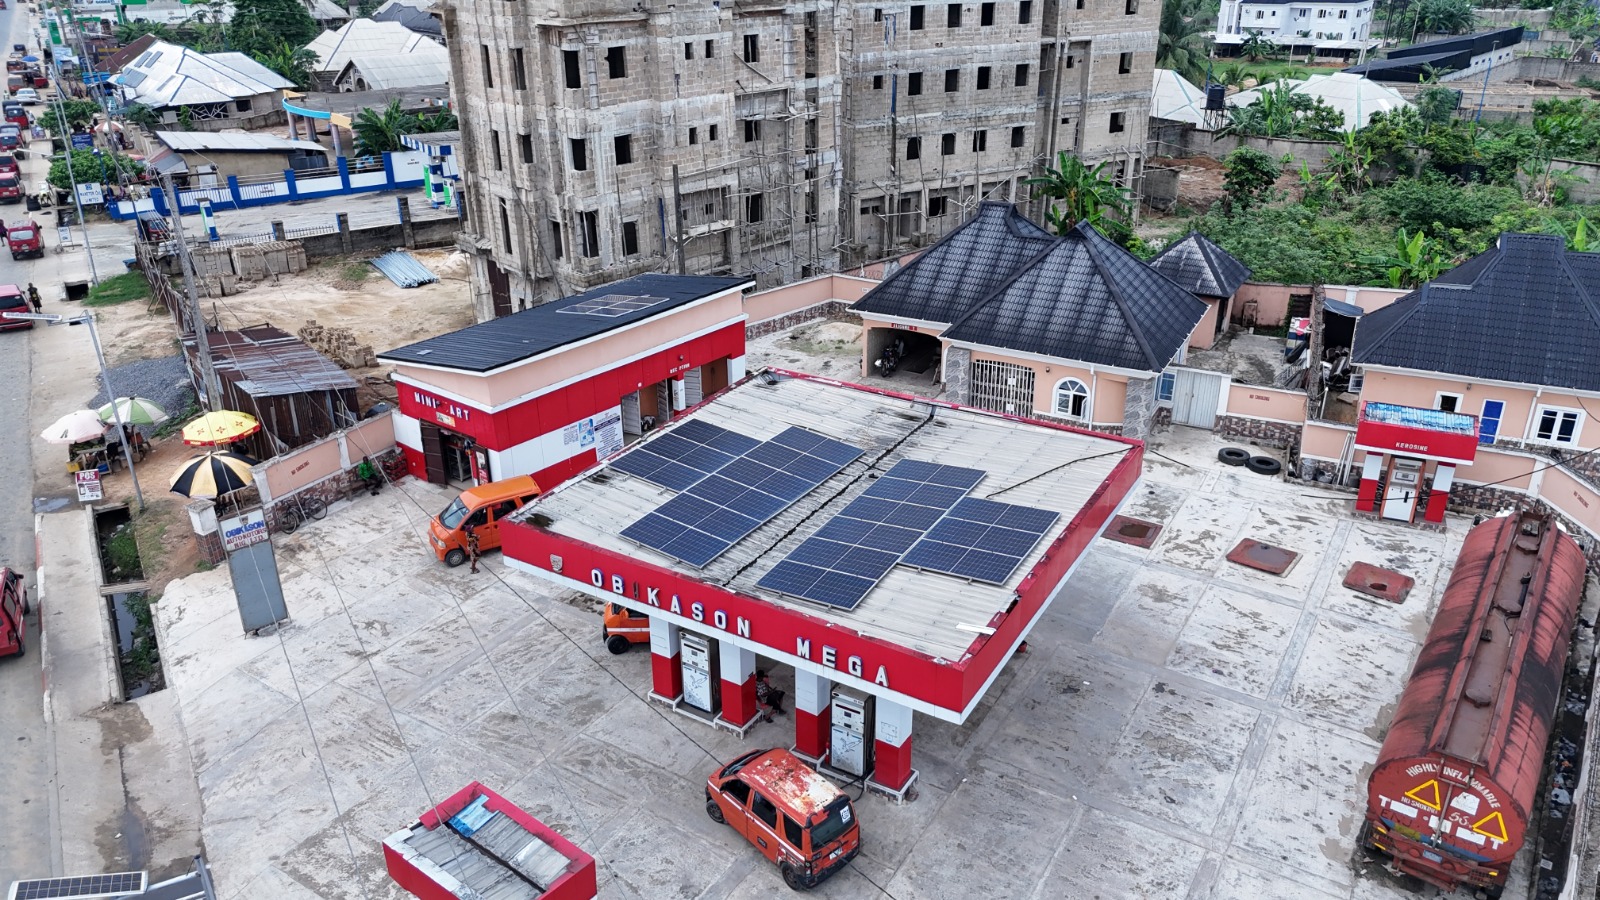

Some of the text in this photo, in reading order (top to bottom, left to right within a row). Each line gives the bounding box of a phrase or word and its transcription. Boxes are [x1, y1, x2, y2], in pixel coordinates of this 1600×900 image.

[414, 392, 437, 408] MINI
[1396, 442, 1429, 452] KEROSINE
[80, 471, 96, 480] POS
[226, 520, 264, 538] OBIKASON
[591, 568, 890, 689] OBIKASON MEGA
[1406, 762, 1501, 809] HIGHLY INFLAMMABLE
